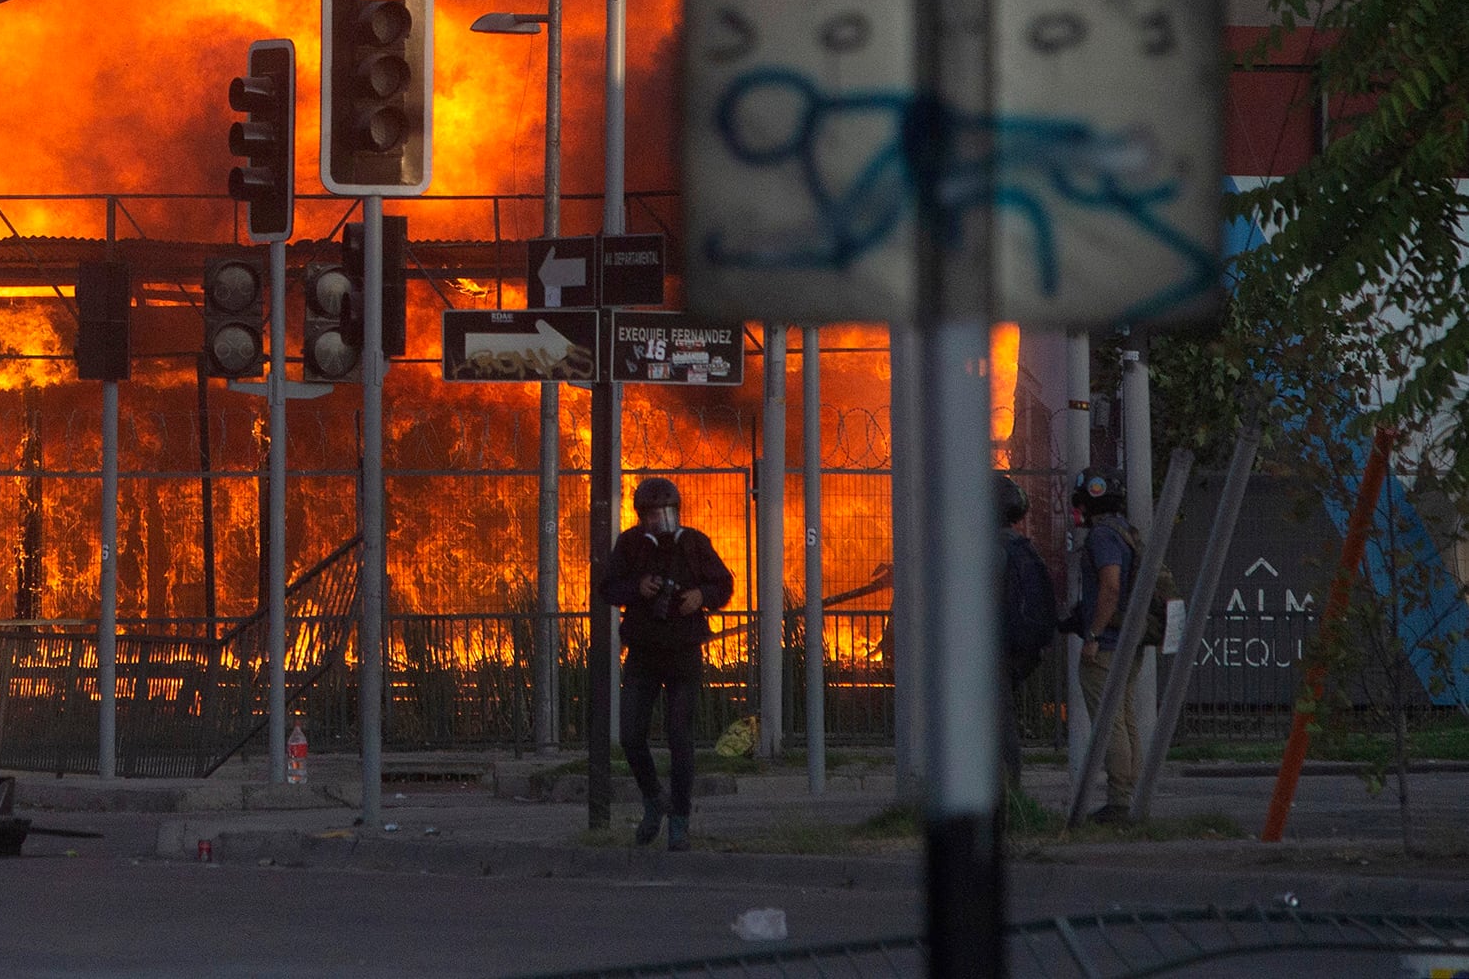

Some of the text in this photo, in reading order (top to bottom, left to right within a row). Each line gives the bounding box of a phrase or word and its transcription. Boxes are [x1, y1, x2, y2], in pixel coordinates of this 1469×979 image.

[618, 326, 732, 345] EXEQUIEL FERNANDEZ
[1192, 637, 1303, 668] XEQUI
